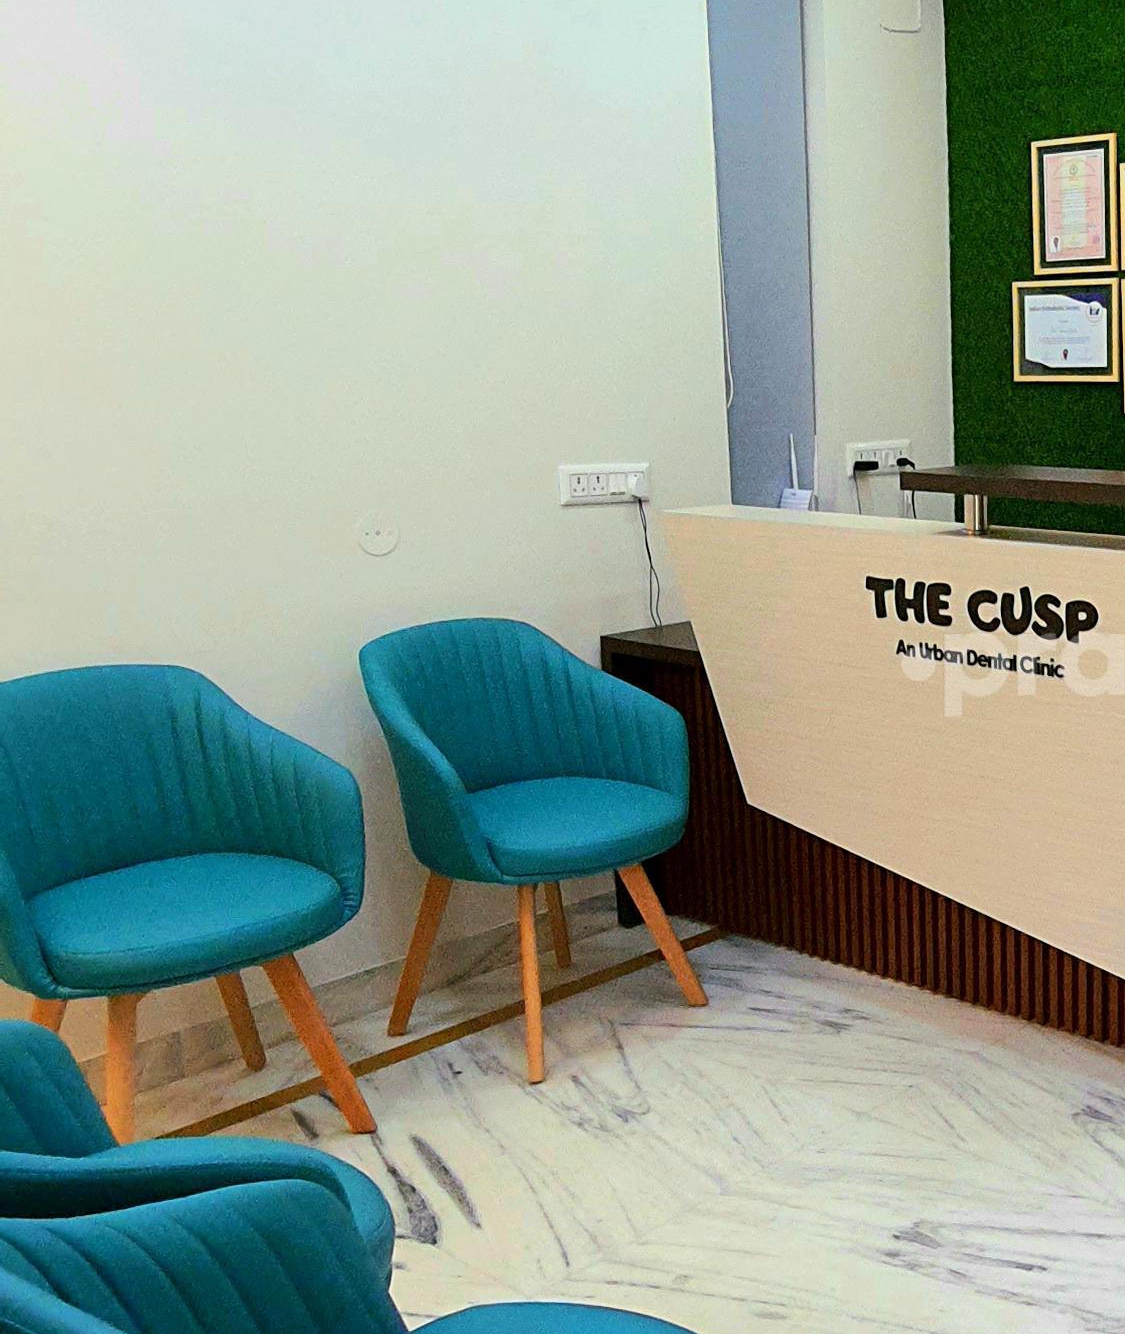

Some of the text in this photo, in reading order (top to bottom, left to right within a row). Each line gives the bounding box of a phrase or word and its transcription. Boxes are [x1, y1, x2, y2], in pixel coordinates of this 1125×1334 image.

[865, 576, 1099, 644] THE CUSP
[895, 639, 1065, 679] An Urban Dental Clinic
